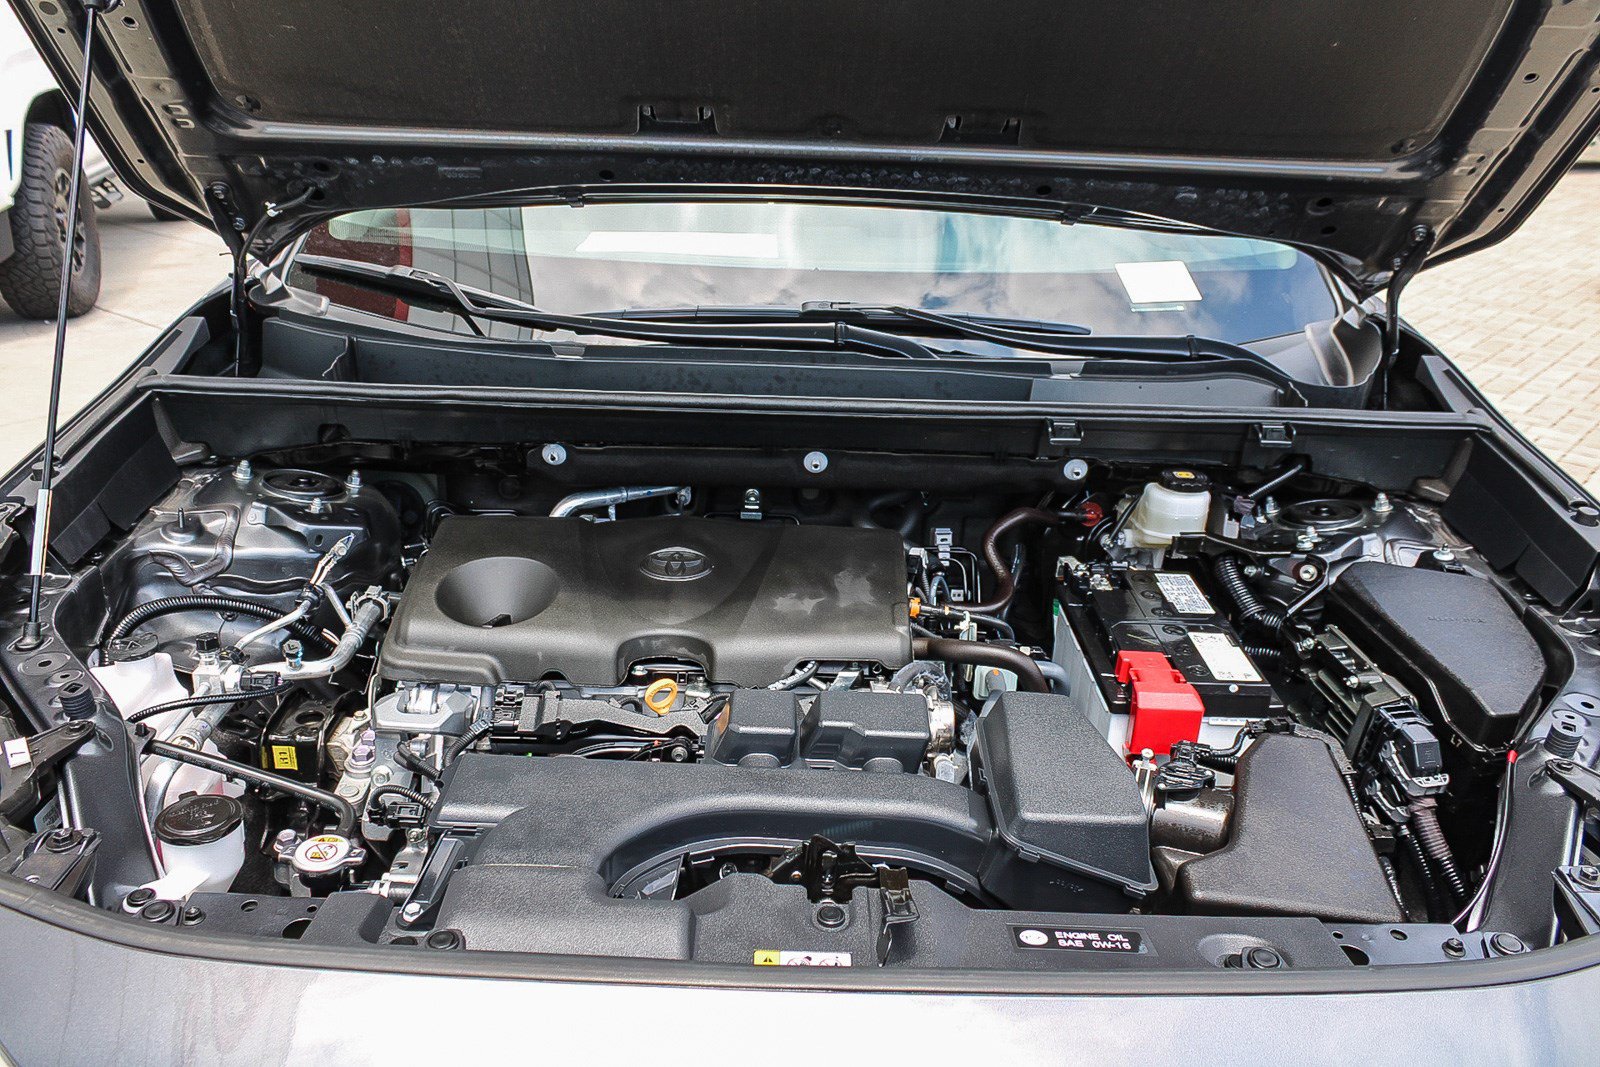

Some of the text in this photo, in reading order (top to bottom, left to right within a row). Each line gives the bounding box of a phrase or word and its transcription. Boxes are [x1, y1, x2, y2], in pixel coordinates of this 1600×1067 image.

[1055, 931, 1129, 942] ENGINE OIL
[1058, 939, 1084, 948] SAE
